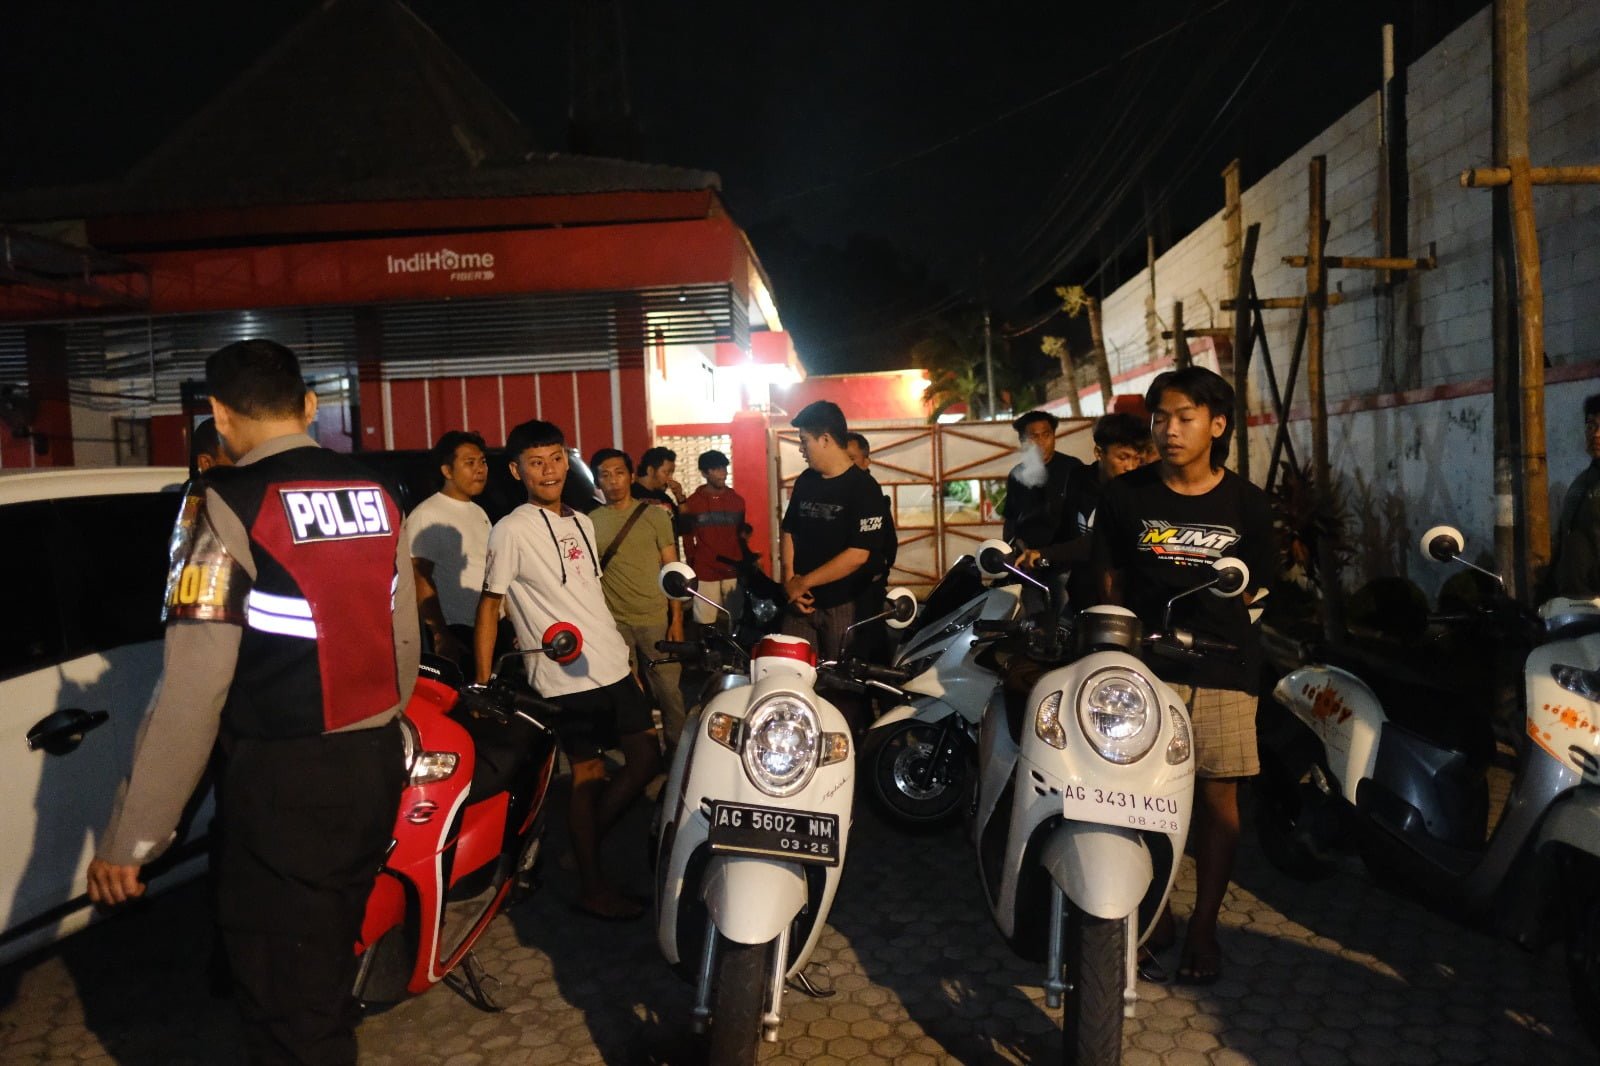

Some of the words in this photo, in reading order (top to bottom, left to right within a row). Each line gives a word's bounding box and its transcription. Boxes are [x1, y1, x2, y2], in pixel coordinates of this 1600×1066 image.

[387, 249, 495, 274] IndiHome
[286, 490, 389, 538] POLISI
[1142, 528, 1237, 550] MJMT
[1065, 785, 1086, 801] AG
[1094, 789, 1136, 809] 3431
[1143, 796, 1178, 815] KCU
[719, 809, 742, 827] AG
[752, 812, 796, 833] 5602
[809, 819, 832, 839] NM
